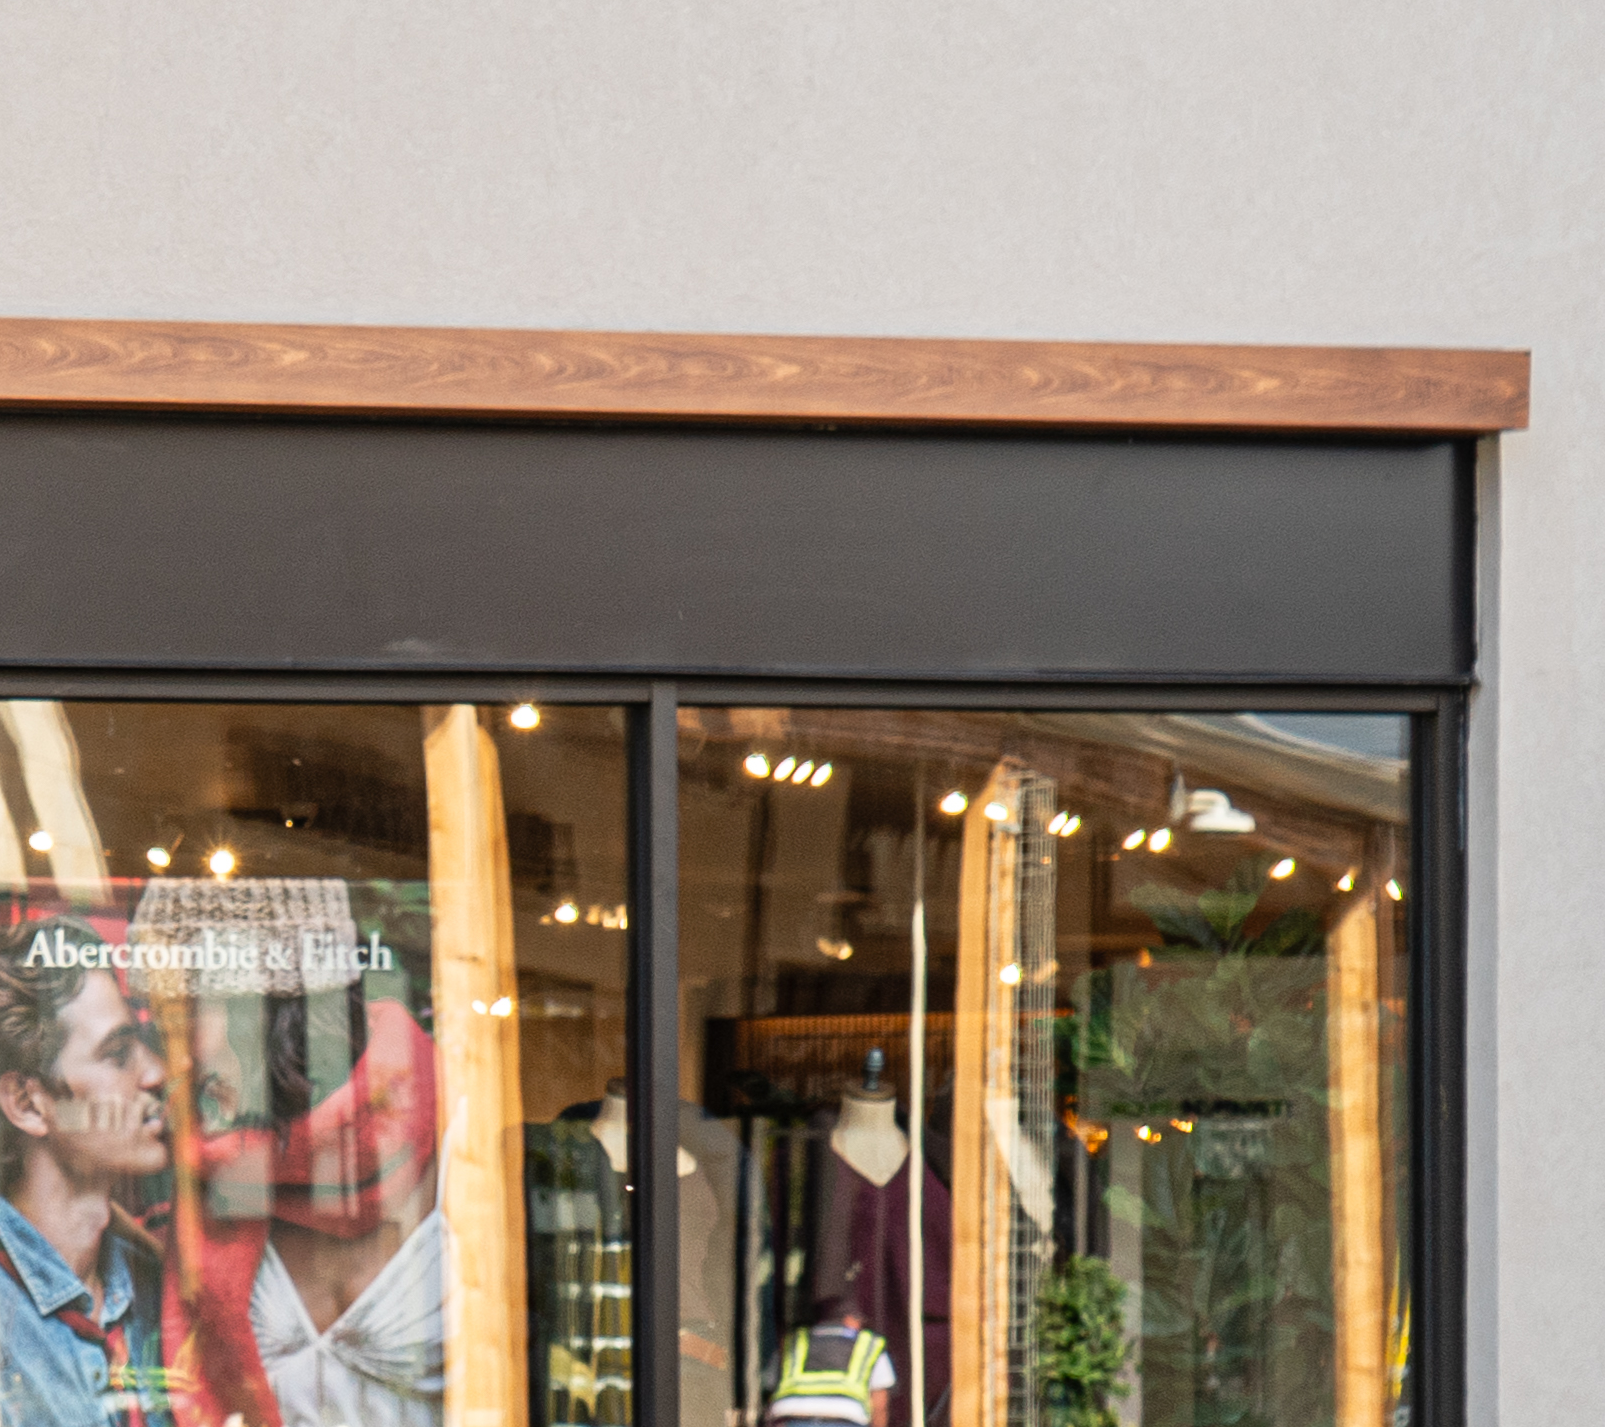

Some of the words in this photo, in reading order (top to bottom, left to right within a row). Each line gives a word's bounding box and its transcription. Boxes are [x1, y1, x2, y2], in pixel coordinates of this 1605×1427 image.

[24, 927, 260, 971] Abercrombie
[265, 939, 294, 971] &
[302, 929, 395, 971] Fitch
